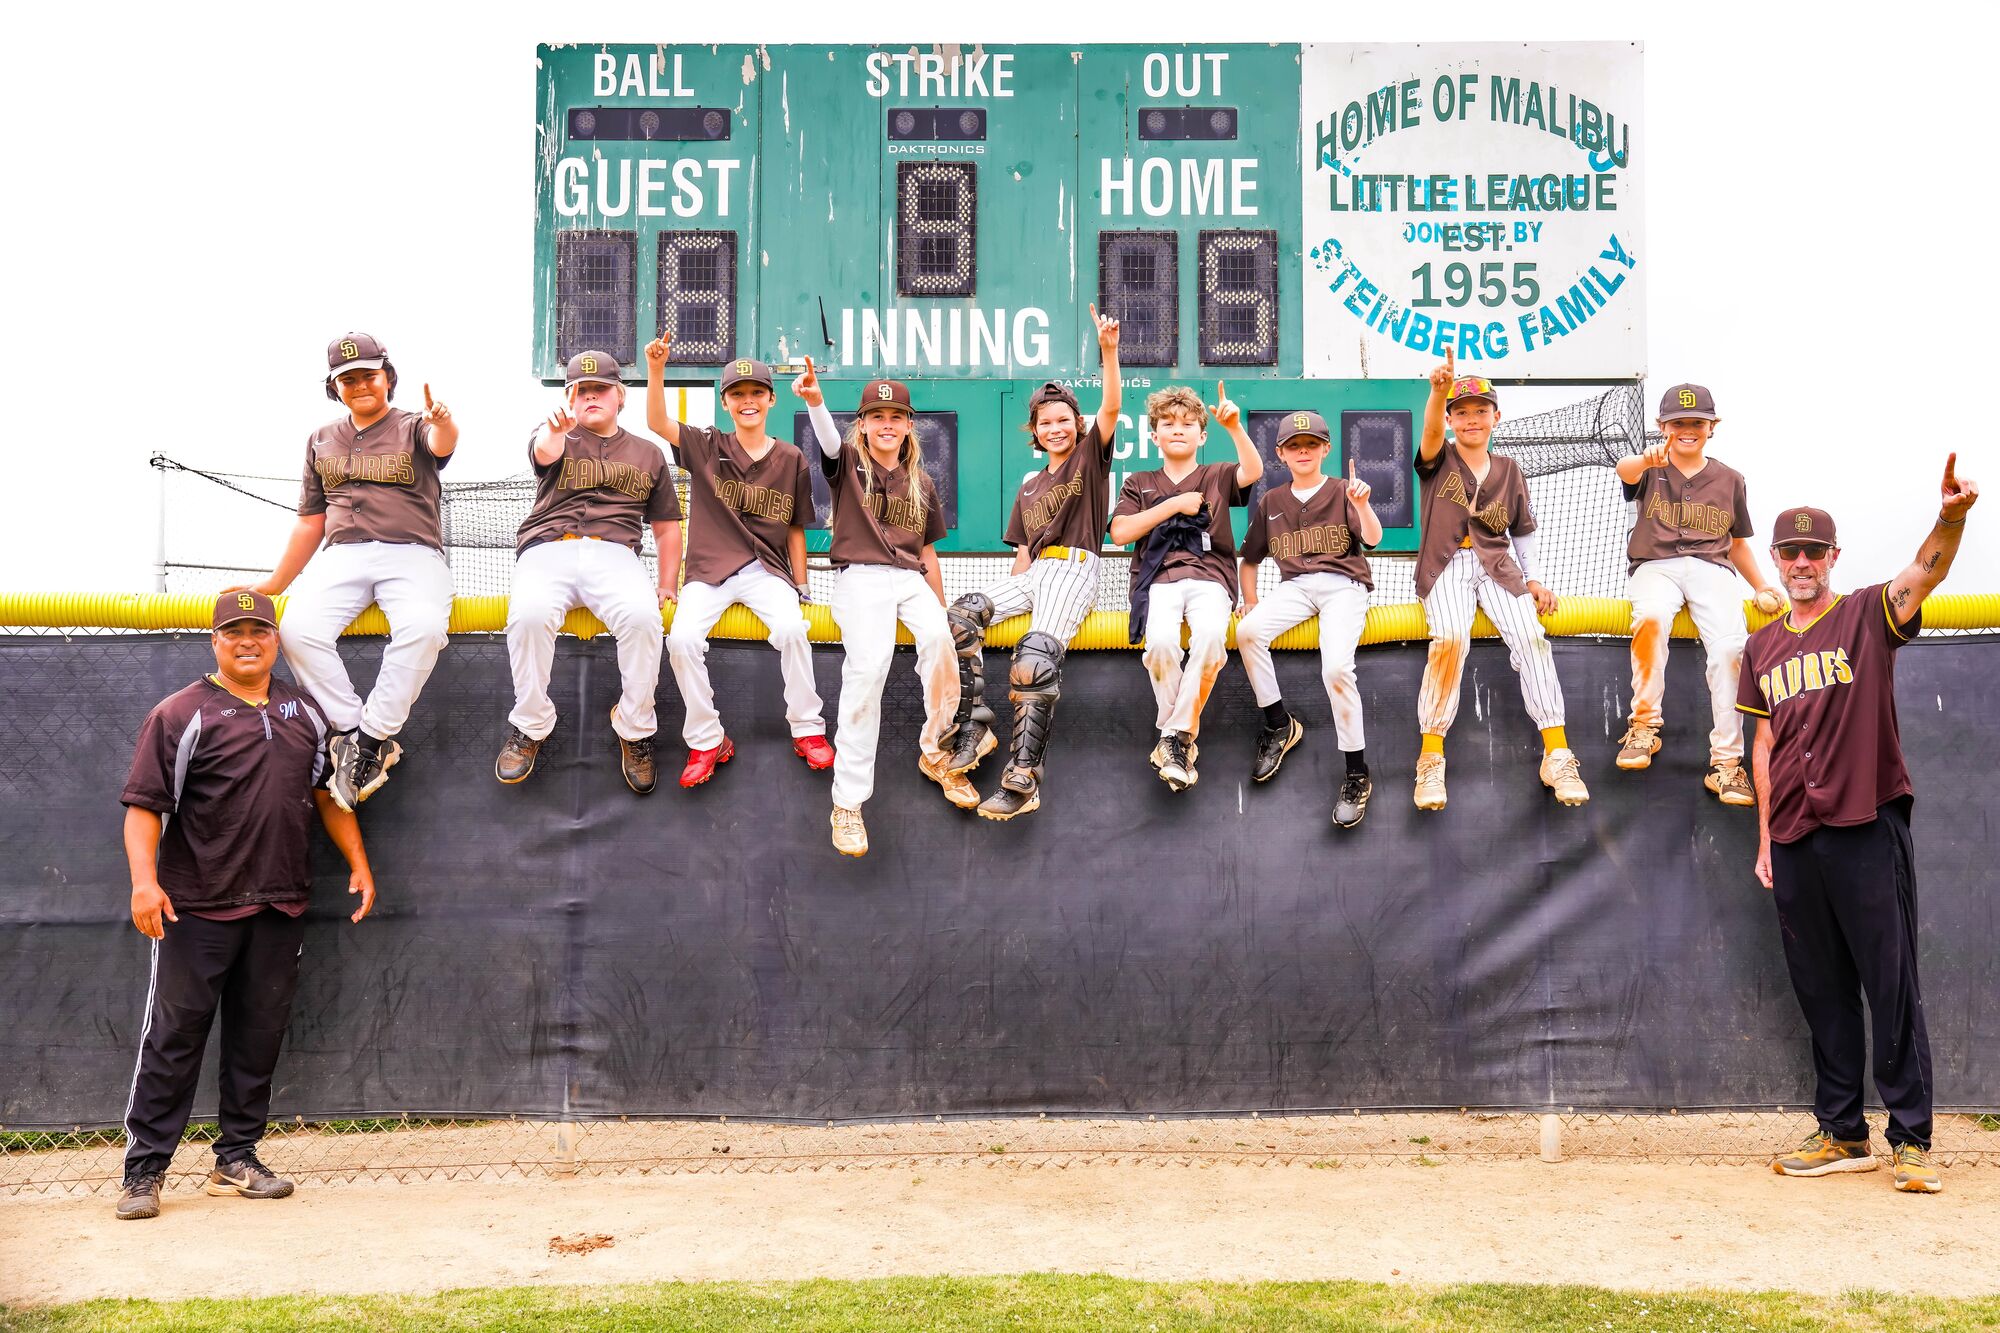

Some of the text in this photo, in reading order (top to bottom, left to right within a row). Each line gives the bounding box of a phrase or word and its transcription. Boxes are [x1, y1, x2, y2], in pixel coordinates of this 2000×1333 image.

[593, 53, 695, 97] BALL
[865, 53, 1015, 97] STRIKE
[1143, 53, 1229, 98] OUT
[1316, 74, 1629, 171] HOME OF MALIBU
[888, 145, 985, 154] DAKTRONICS
[554, 158, 740, 217] GUEST
[1100, 158, 1259, 217] HOME
[1330, 173, 1617, 212] LITTLE LEAGUE
[905, 167, 971, 289] 9
[1402, 221, 1544, 243] DONATE BY
[1443, 225, 1513, 252] EST.
[664, 235, 729, 356] 6
[1205, 236, 1270, 356] 5
[1310, 233, 1636, 361] STEINBERG FAMILY
[1412, 262, 1541, 307] 1955
[842, 307, 1050, 367] INNING
[1053, 379, 1151, 388] DAKTRNICS
[558, 457, 653, 502] PADRES
[1269, 525, 1351, 561] PADRES
[1759, 648, 1853, 708] PADRES
